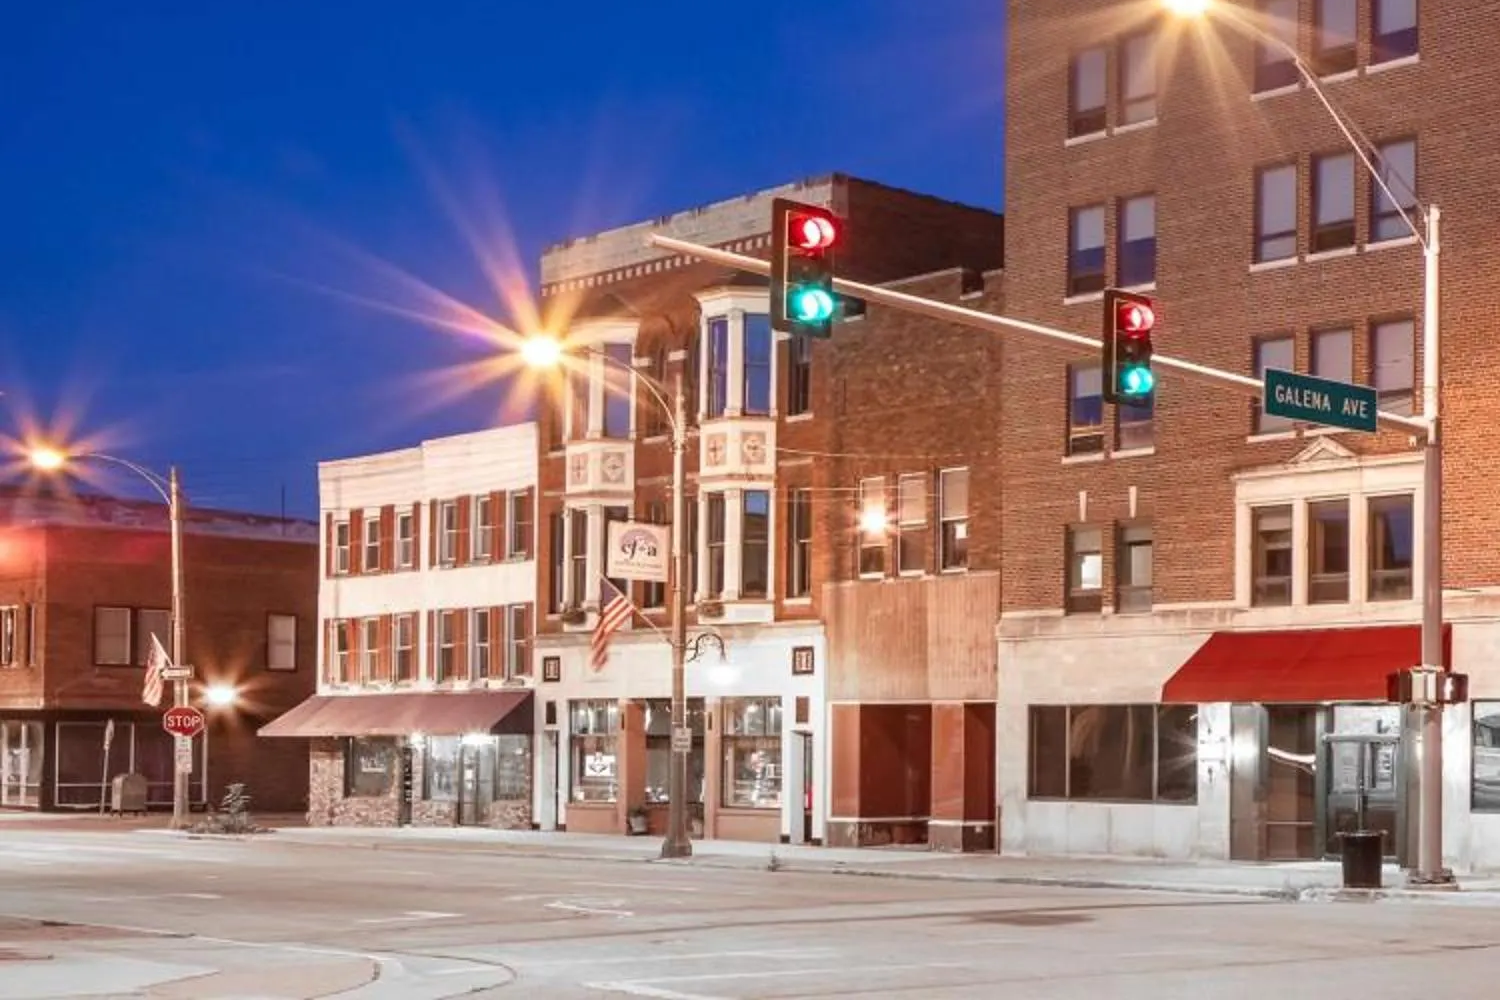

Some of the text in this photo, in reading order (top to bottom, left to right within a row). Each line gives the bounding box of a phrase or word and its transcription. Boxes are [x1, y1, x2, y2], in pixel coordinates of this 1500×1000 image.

[1275, 384, 1369, 418] GALENA AVE
[167, 715, 201, 727] STOP
